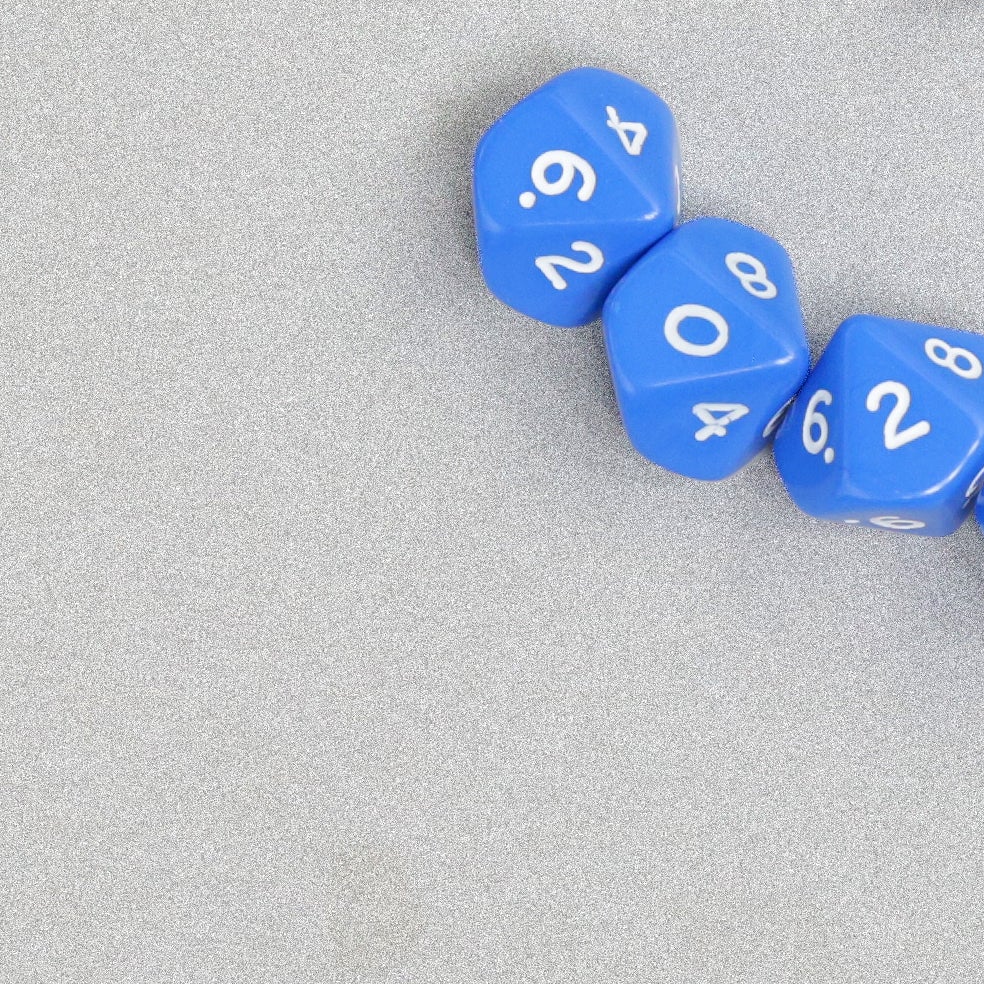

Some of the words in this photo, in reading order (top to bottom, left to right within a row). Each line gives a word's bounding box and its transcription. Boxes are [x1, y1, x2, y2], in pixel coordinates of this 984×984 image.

[605, 105, 649, 156] 4
[534, 240, 605, 291] 2
[724, 251, 778, 300] 8
[663, 303, 730, 358] 0
[923, 337, 984, 380] 8
[692, 402, 751, 442] 4
[865, 380, 932, 451] 2
